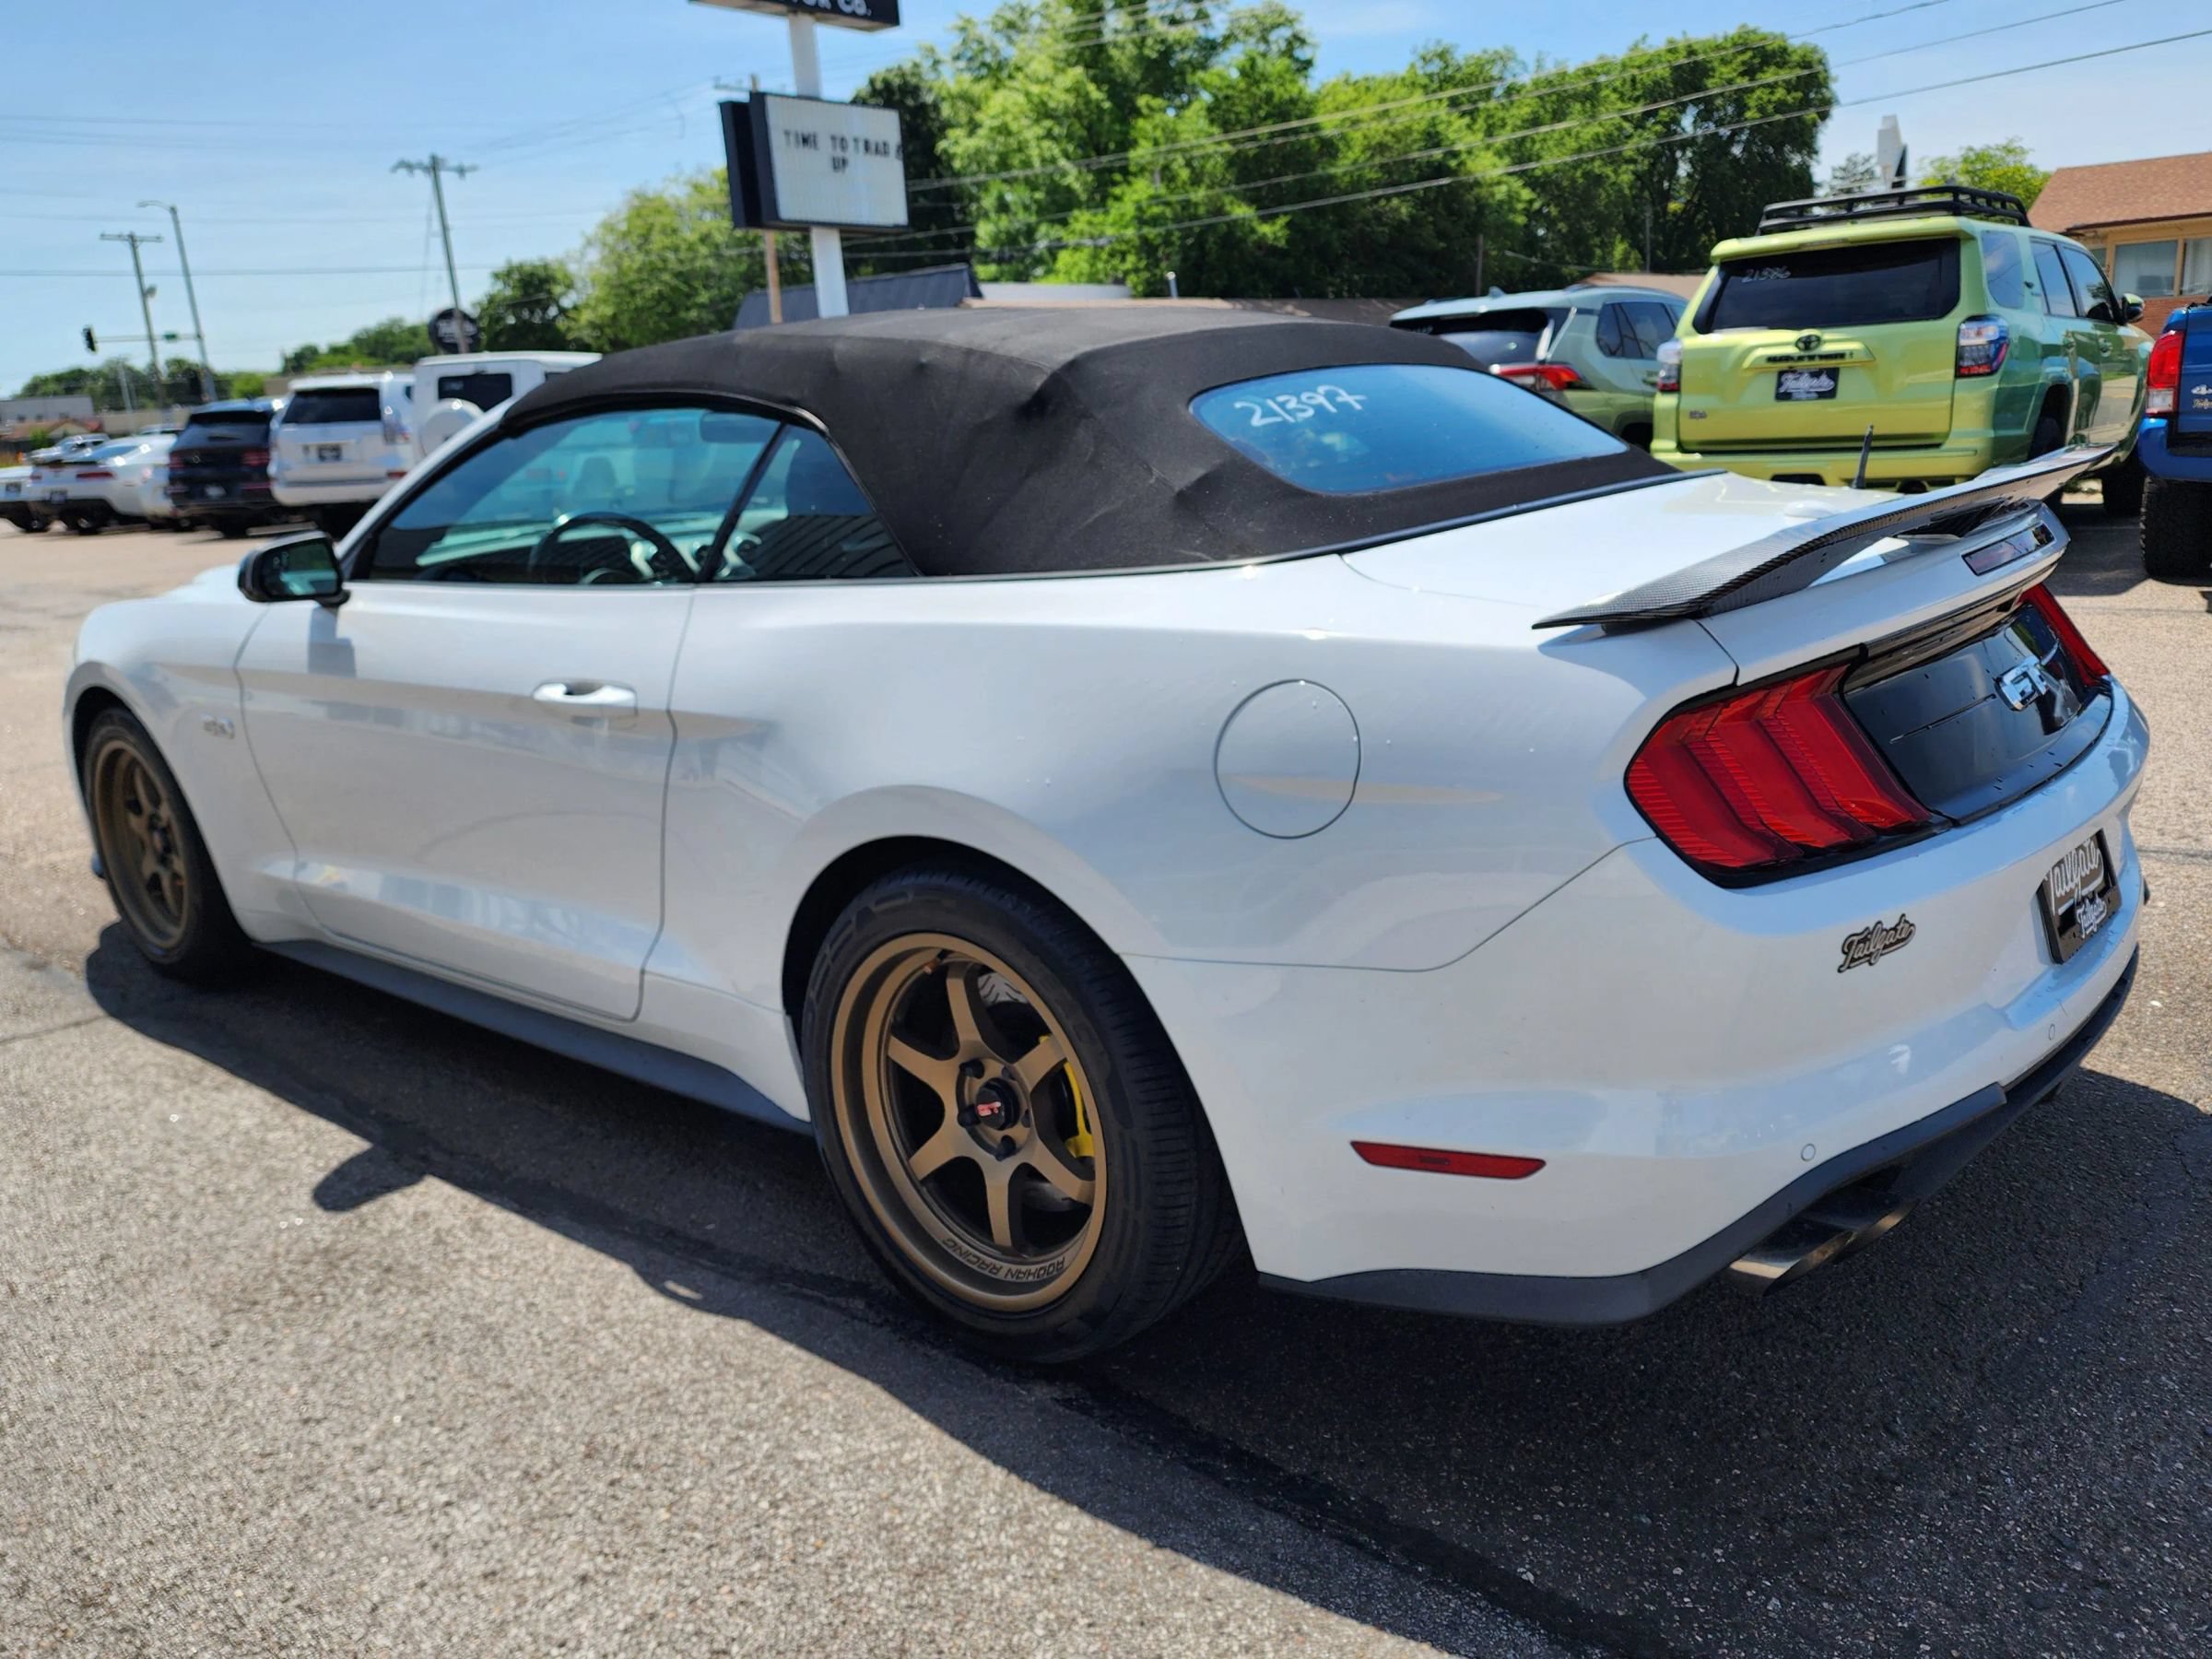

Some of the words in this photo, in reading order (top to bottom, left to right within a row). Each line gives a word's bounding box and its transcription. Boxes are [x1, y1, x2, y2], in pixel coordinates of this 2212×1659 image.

[784, 129, 818, 150] TIME
[830, 134, 848, 153] TO
[832, 156, 848, 173] UP
[1233, 384, 1368, 428] 21397
[1994, 655, 2047, 712] GT
[1837, 912, 1916, 973] Tailgate
[942, 1237, 1004, 1277] RACING
